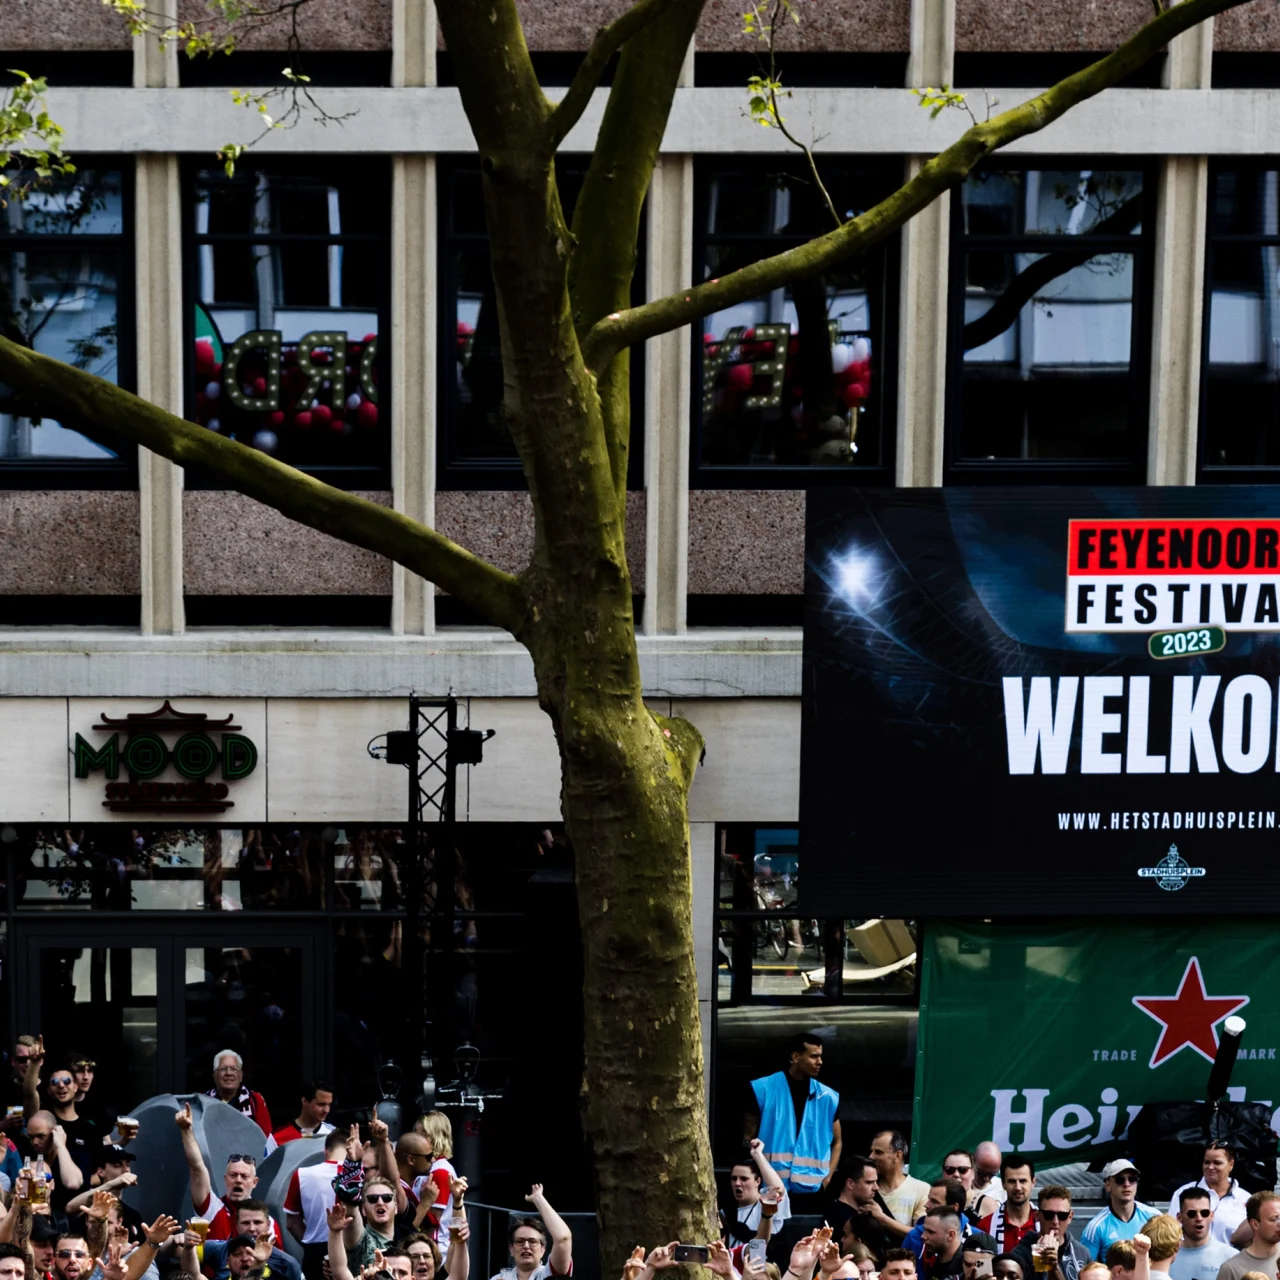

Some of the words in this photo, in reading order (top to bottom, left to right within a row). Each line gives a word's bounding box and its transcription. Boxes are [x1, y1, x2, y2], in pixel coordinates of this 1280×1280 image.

[1162, 630, 1211, 655] 2023
[74, 732, 258, 779] MOOD
[1092, 1050, 1137, 1062] TRADE
[1236, 1048, 1276, 1060] MARK
